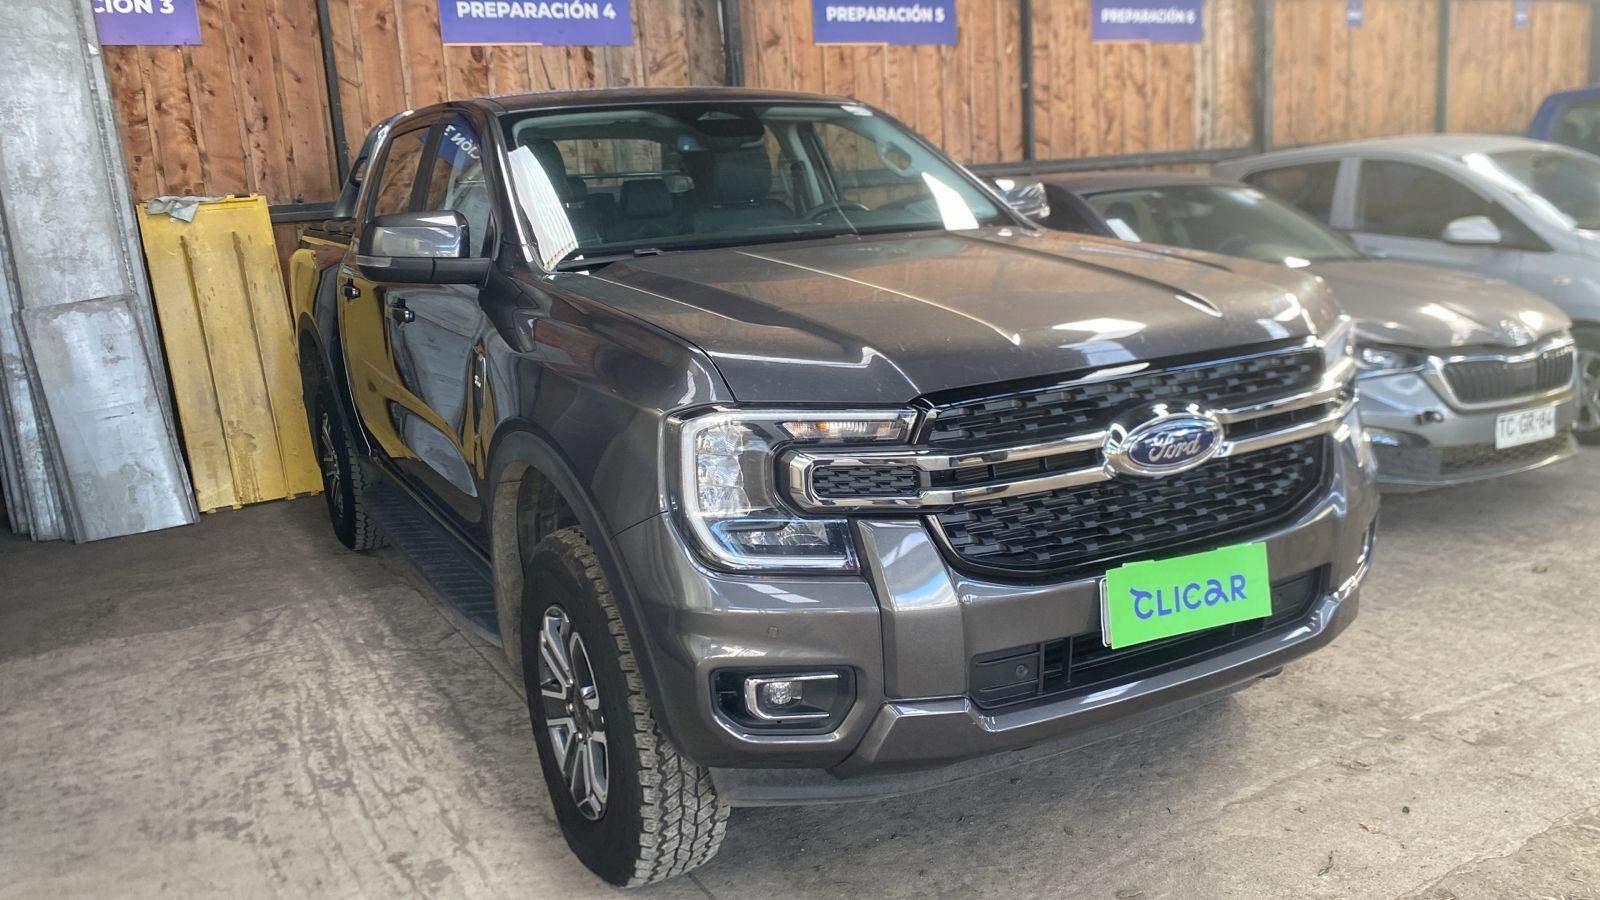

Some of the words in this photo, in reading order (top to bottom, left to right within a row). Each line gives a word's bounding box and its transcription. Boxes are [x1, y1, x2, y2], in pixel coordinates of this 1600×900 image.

[456, 0, 599, 19] PREPARACIÓN
[602, 2, 617, 19] 4
[826, 4, 933, 22] PREPARACIÓN
[935, 7, 946, 23] 5
[1146, 431, 1202, 463] Ford
